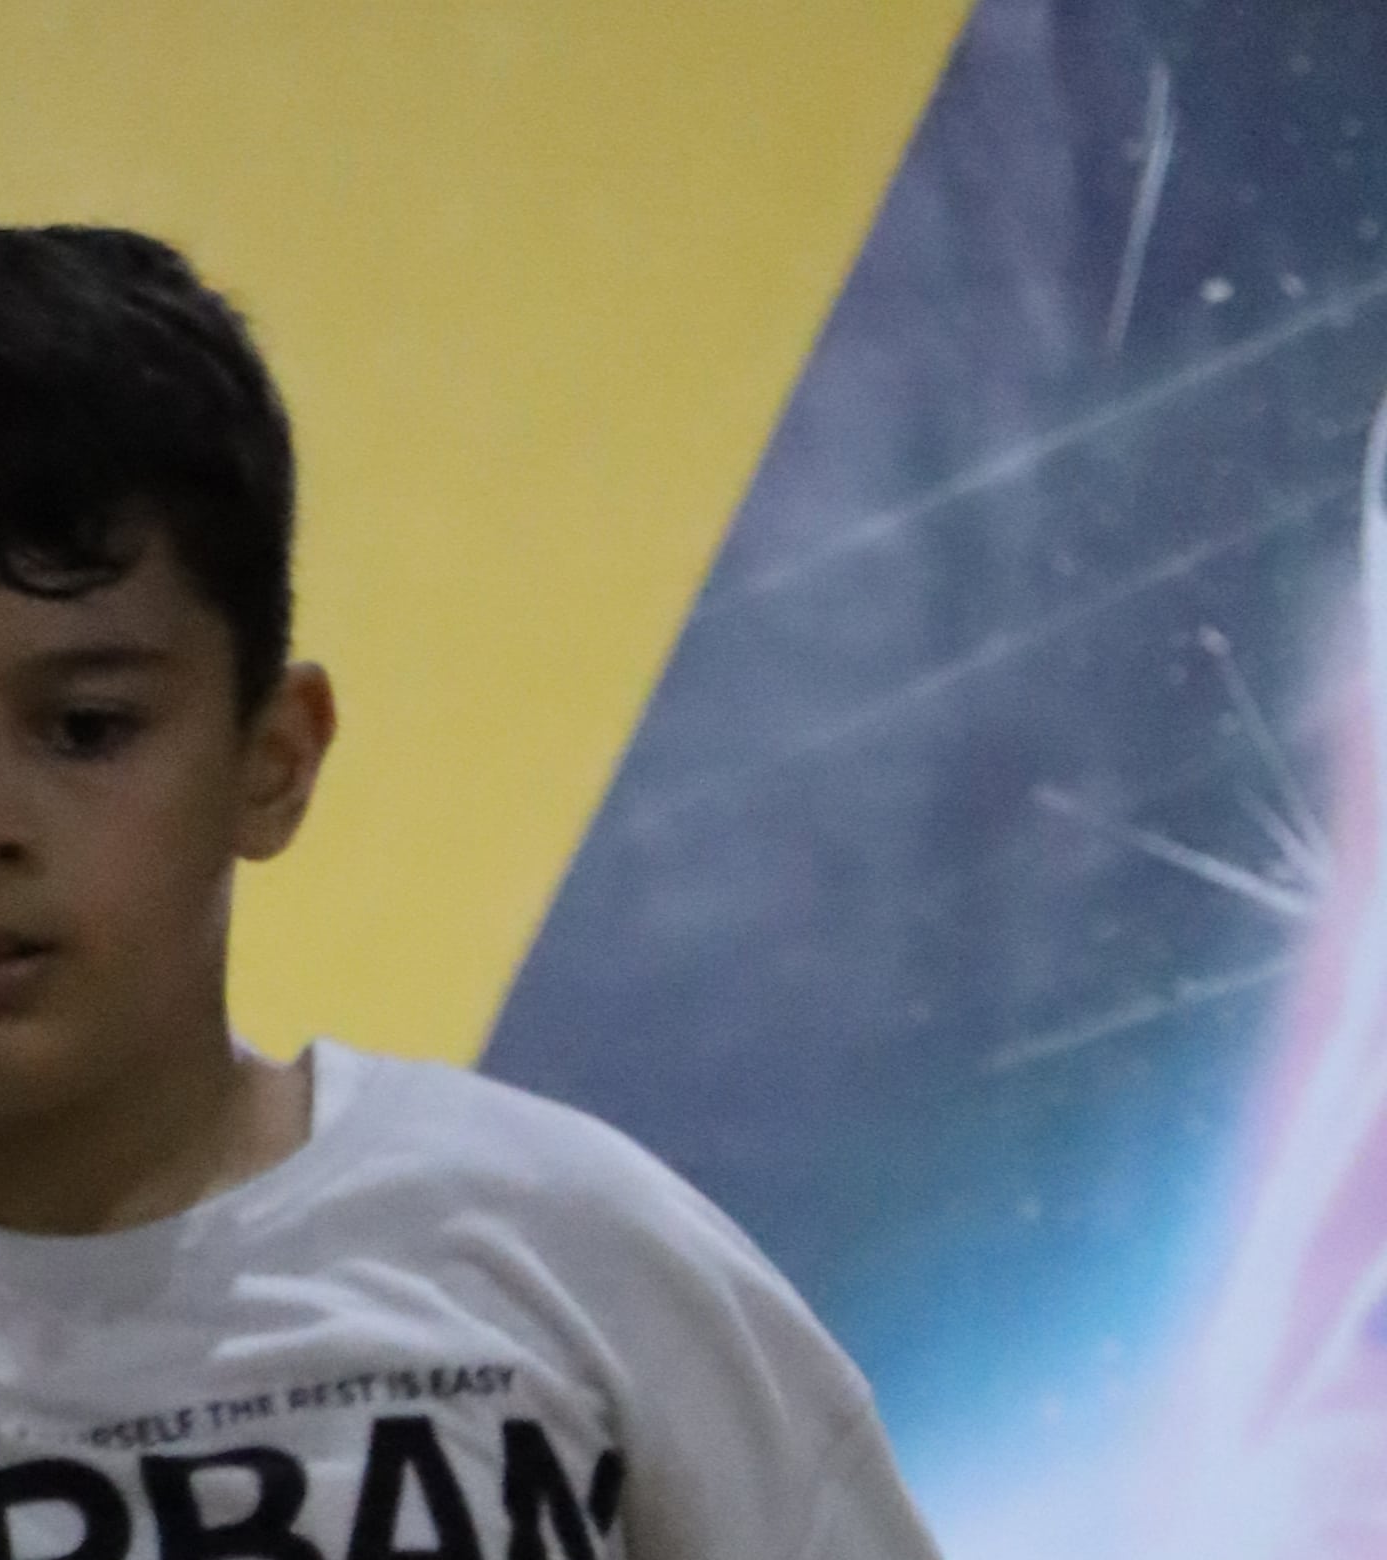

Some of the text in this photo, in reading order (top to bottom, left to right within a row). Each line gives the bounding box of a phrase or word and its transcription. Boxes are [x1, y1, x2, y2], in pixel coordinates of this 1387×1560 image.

[206, 1395, 273, 1430] THE
[287, 1371, 377, 1410] REST
[387, 1367, 423, 1401] IS
[430, 1364, 515, 1398] EASY
